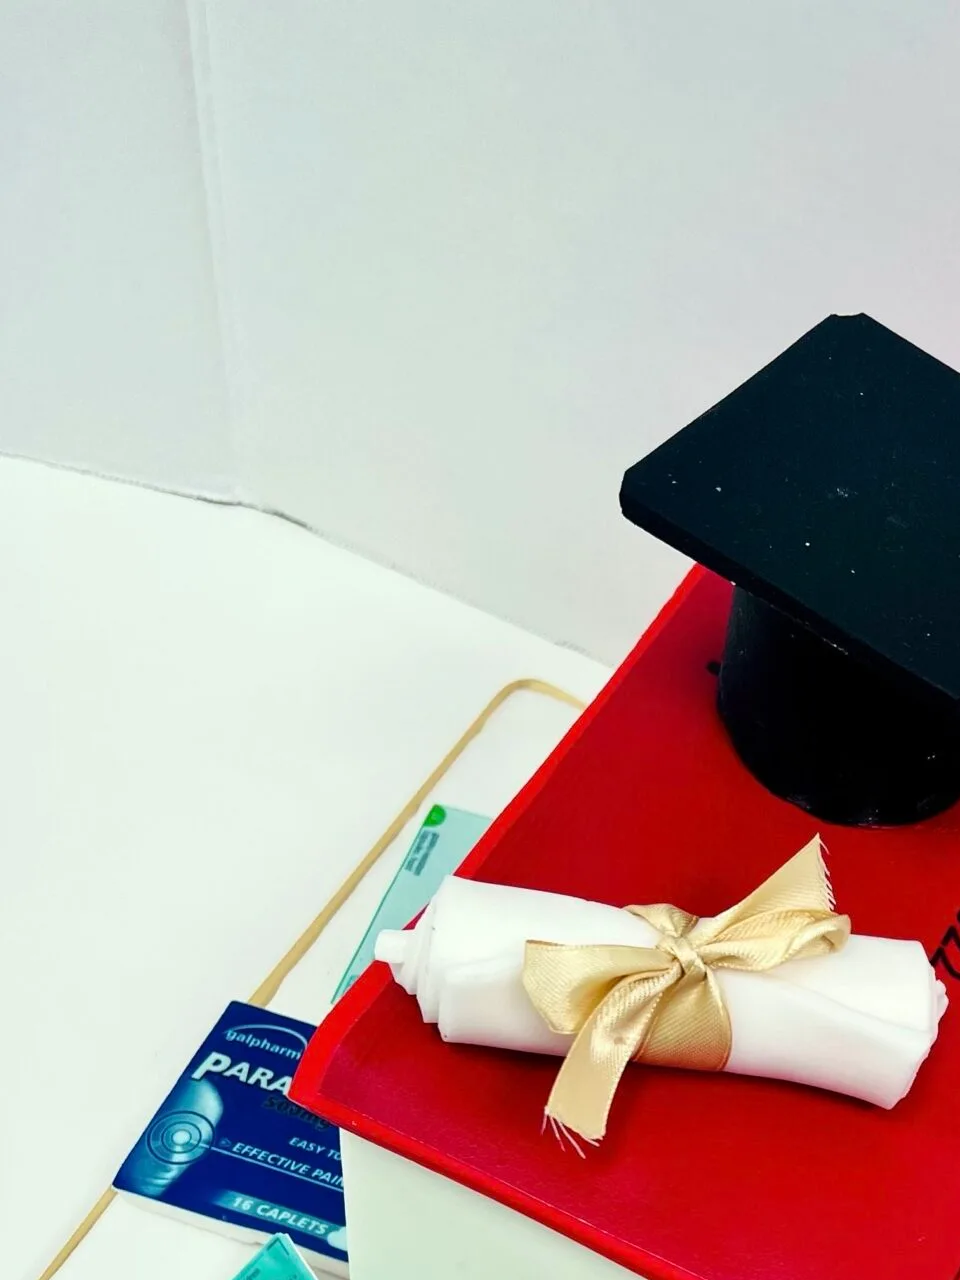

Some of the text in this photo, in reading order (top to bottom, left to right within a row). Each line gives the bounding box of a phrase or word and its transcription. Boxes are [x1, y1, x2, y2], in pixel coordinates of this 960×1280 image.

[224, 1029, 301, 1060] galpharm
[191, 1051, 292, 1096] PARA
[232, 1142, 311, 1175] EFFECTIVE
[288, 1137, 326, 1155] EASY
[232, 1197, 329, 1235] 16 CAPLETS
